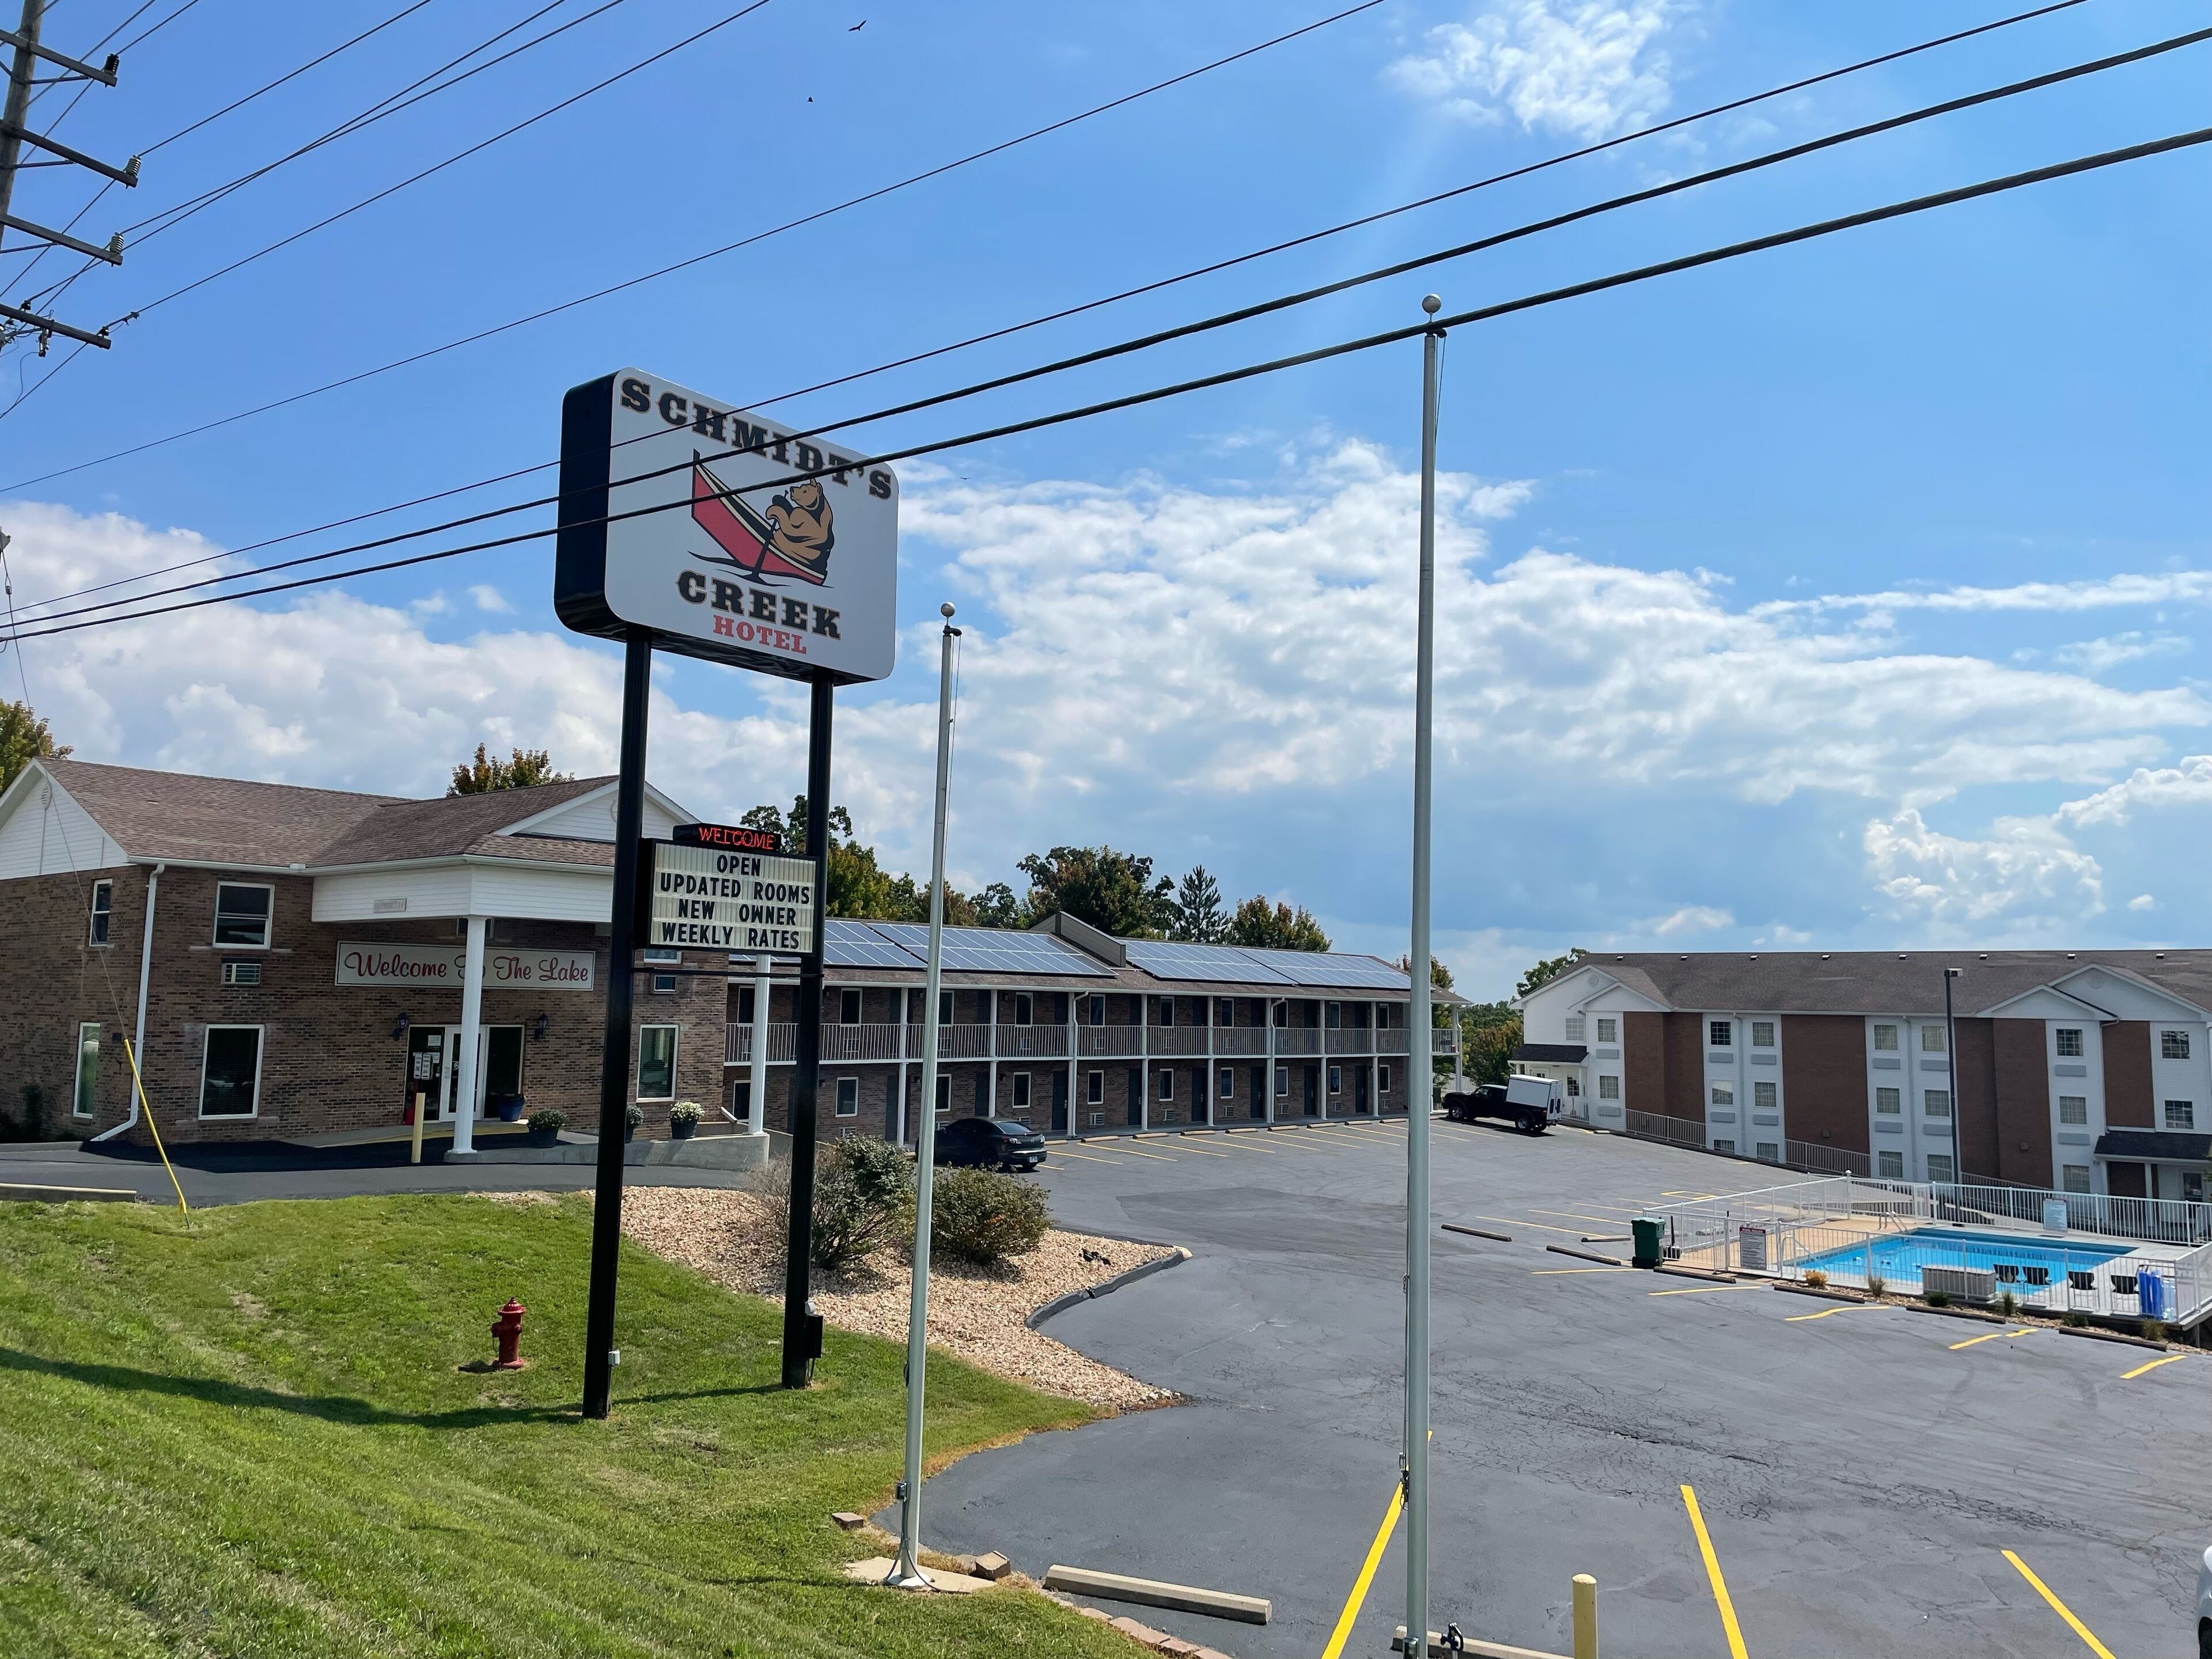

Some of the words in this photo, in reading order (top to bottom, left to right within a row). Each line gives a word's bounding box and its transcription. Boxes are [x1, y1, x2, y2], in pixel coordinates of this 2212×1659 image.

[620, 377, 892, 501] SCHMIDT'S
[675, 569, 841, 641] CREEK
[713, 615, 807, 654] HOTEL
[699, 827, 776, 850] WELCOME
[717, 855, 760, 876] OPEN
[661, 873, 741, 897] UPDATED
[753, 881, 809, 904] ROOMS
[679, 899, 715, 919] NEW
[739, 904, 796, 926] OWNER
[662, 922, 733, 944] WEEKLY
[748, 929, 799, 949] RATES
[344, 952, 447, 978] Welcome
[493, 956, 531, 980] The
[539, 957, 588, 981] Lake
